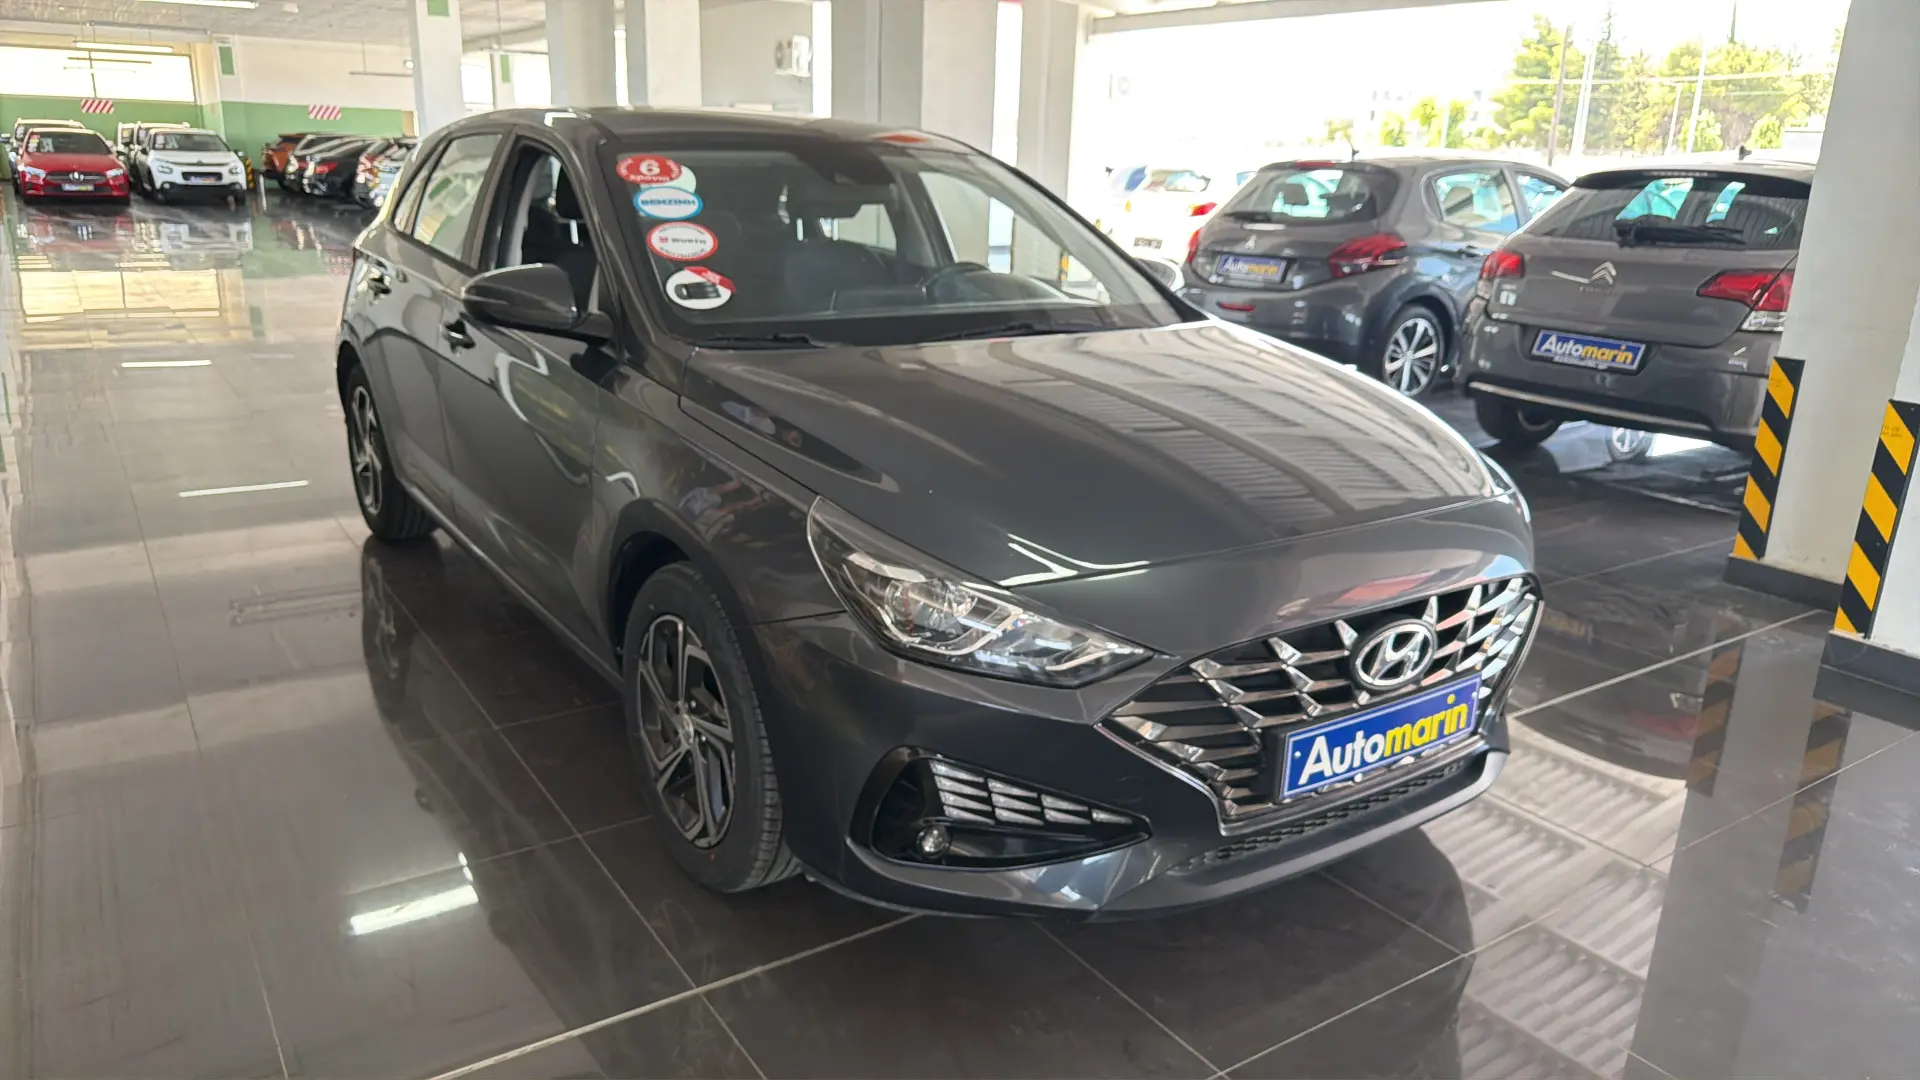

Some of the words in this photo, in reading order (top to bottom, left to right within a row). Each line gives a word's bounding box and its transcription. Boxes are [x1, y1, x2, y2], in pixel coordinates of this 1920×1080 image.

[639, 159, 660, 176] 6
[1541, 333, 1634, 365] Automarin
[1298, 693, 1469, 786] Automarin
